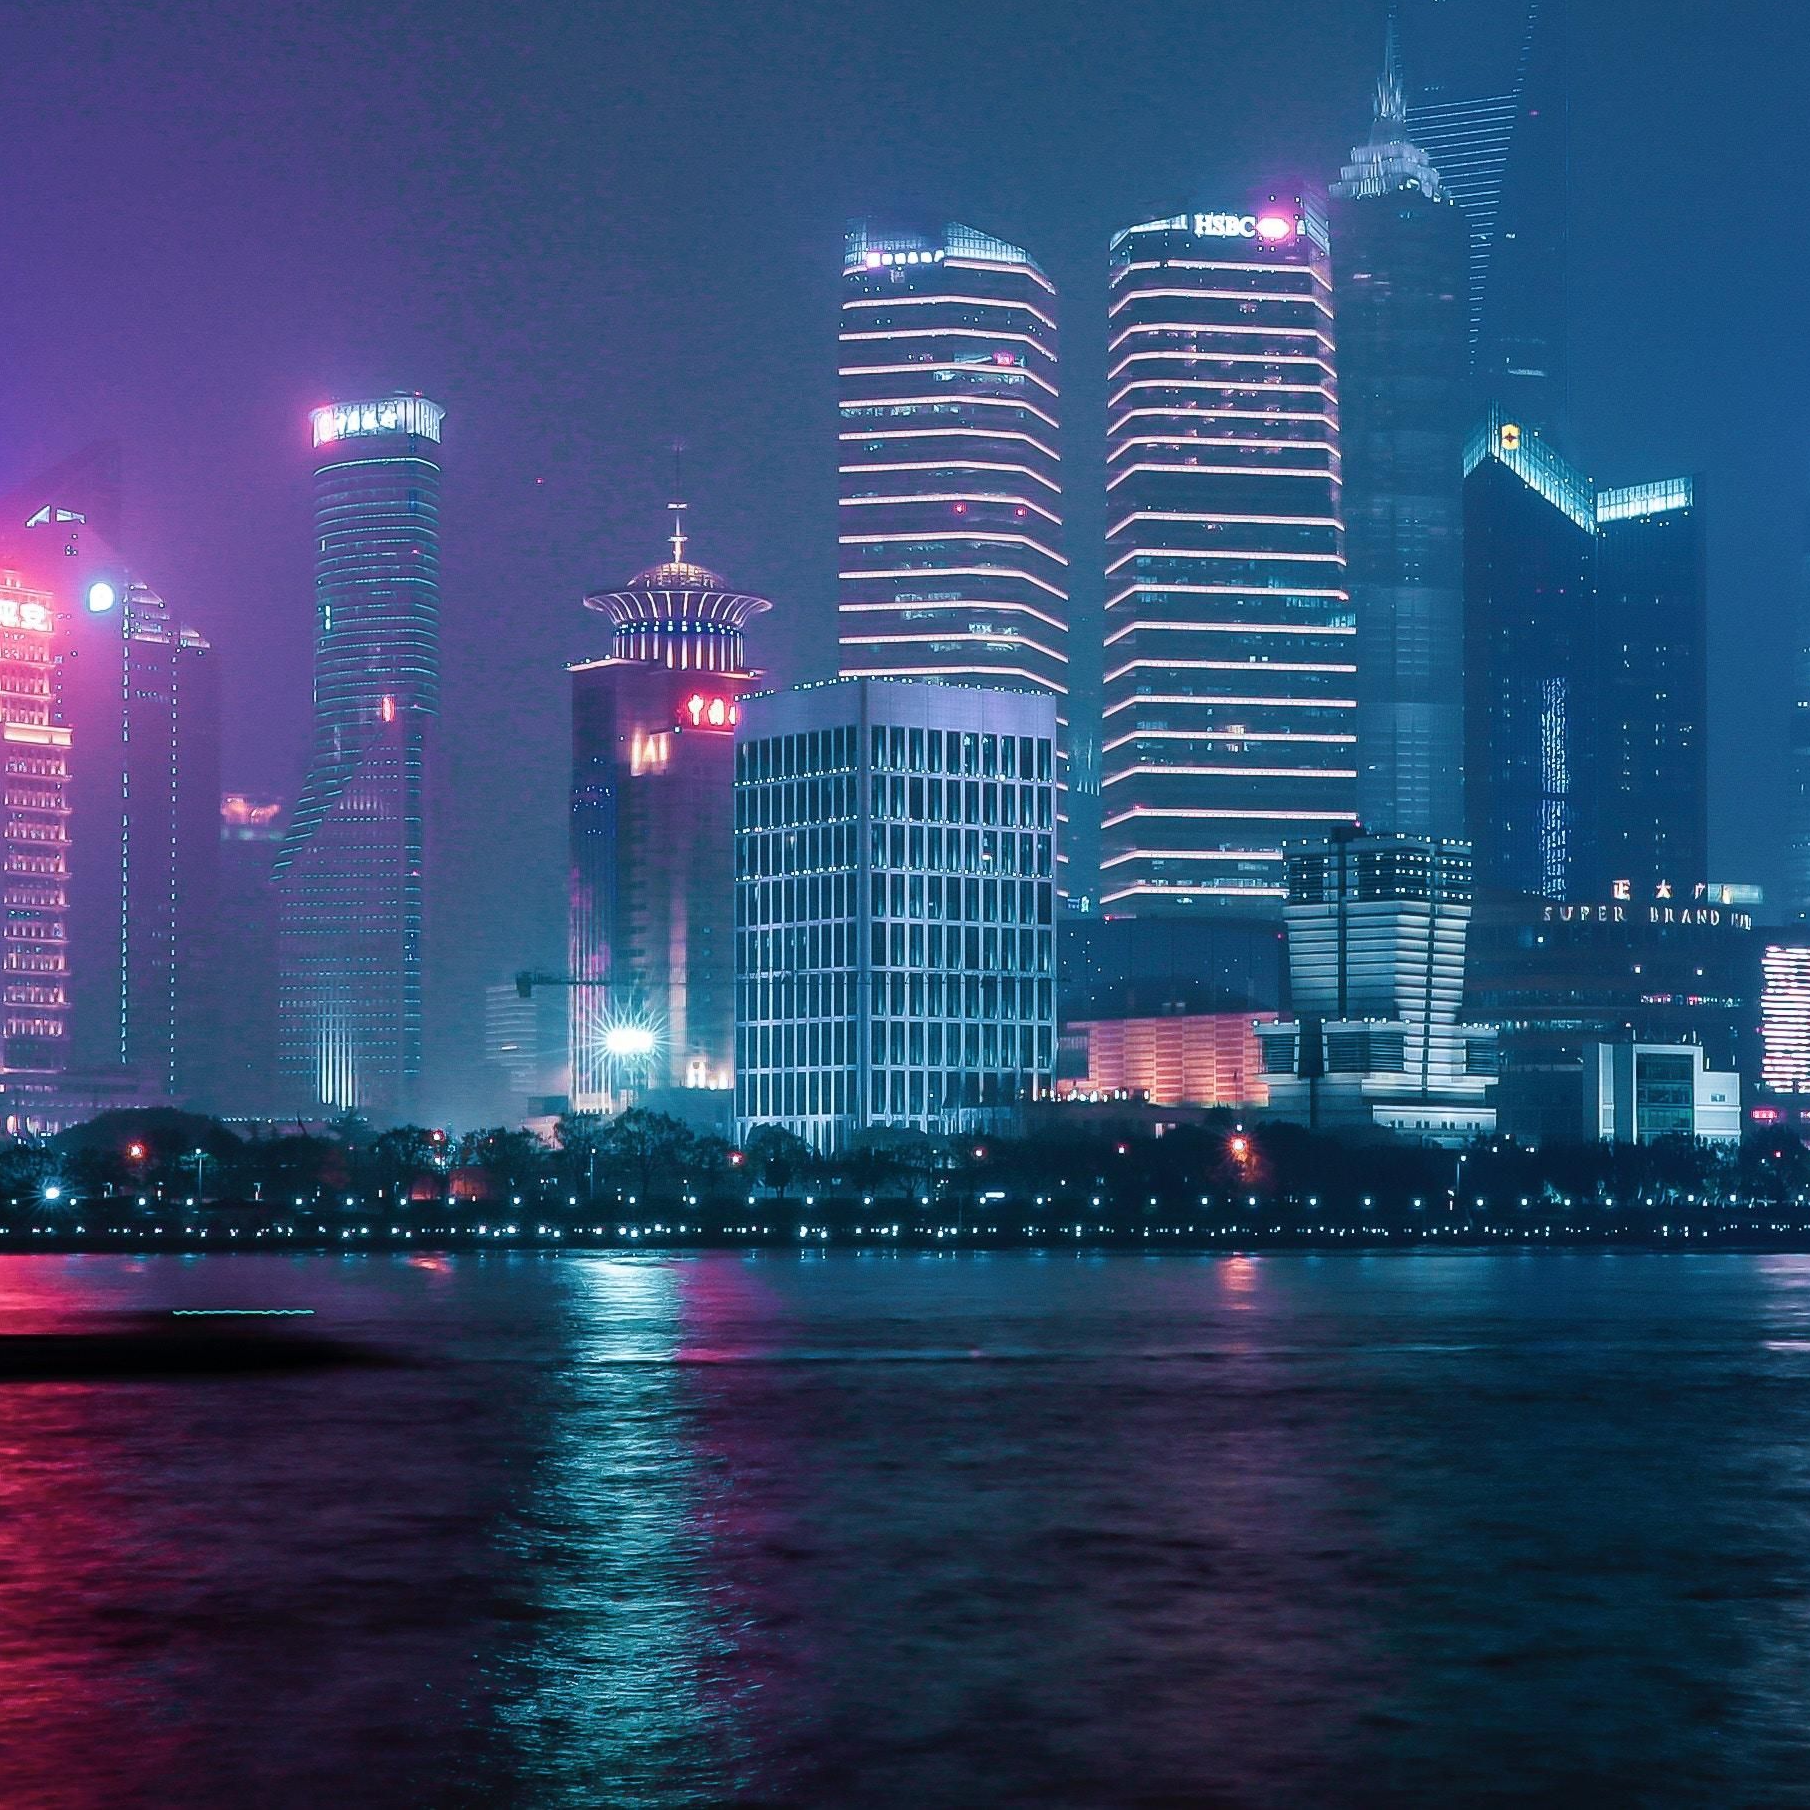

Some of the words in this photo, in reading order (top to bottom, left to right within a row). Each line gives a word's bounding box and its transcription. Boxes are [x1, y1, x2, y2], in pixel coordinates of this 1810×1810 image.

[1193, 212, 1256, 238] HSBC
[1543, 905, 1627, 922] SUPER
[1649, 906, 1720, 927] BRAND
